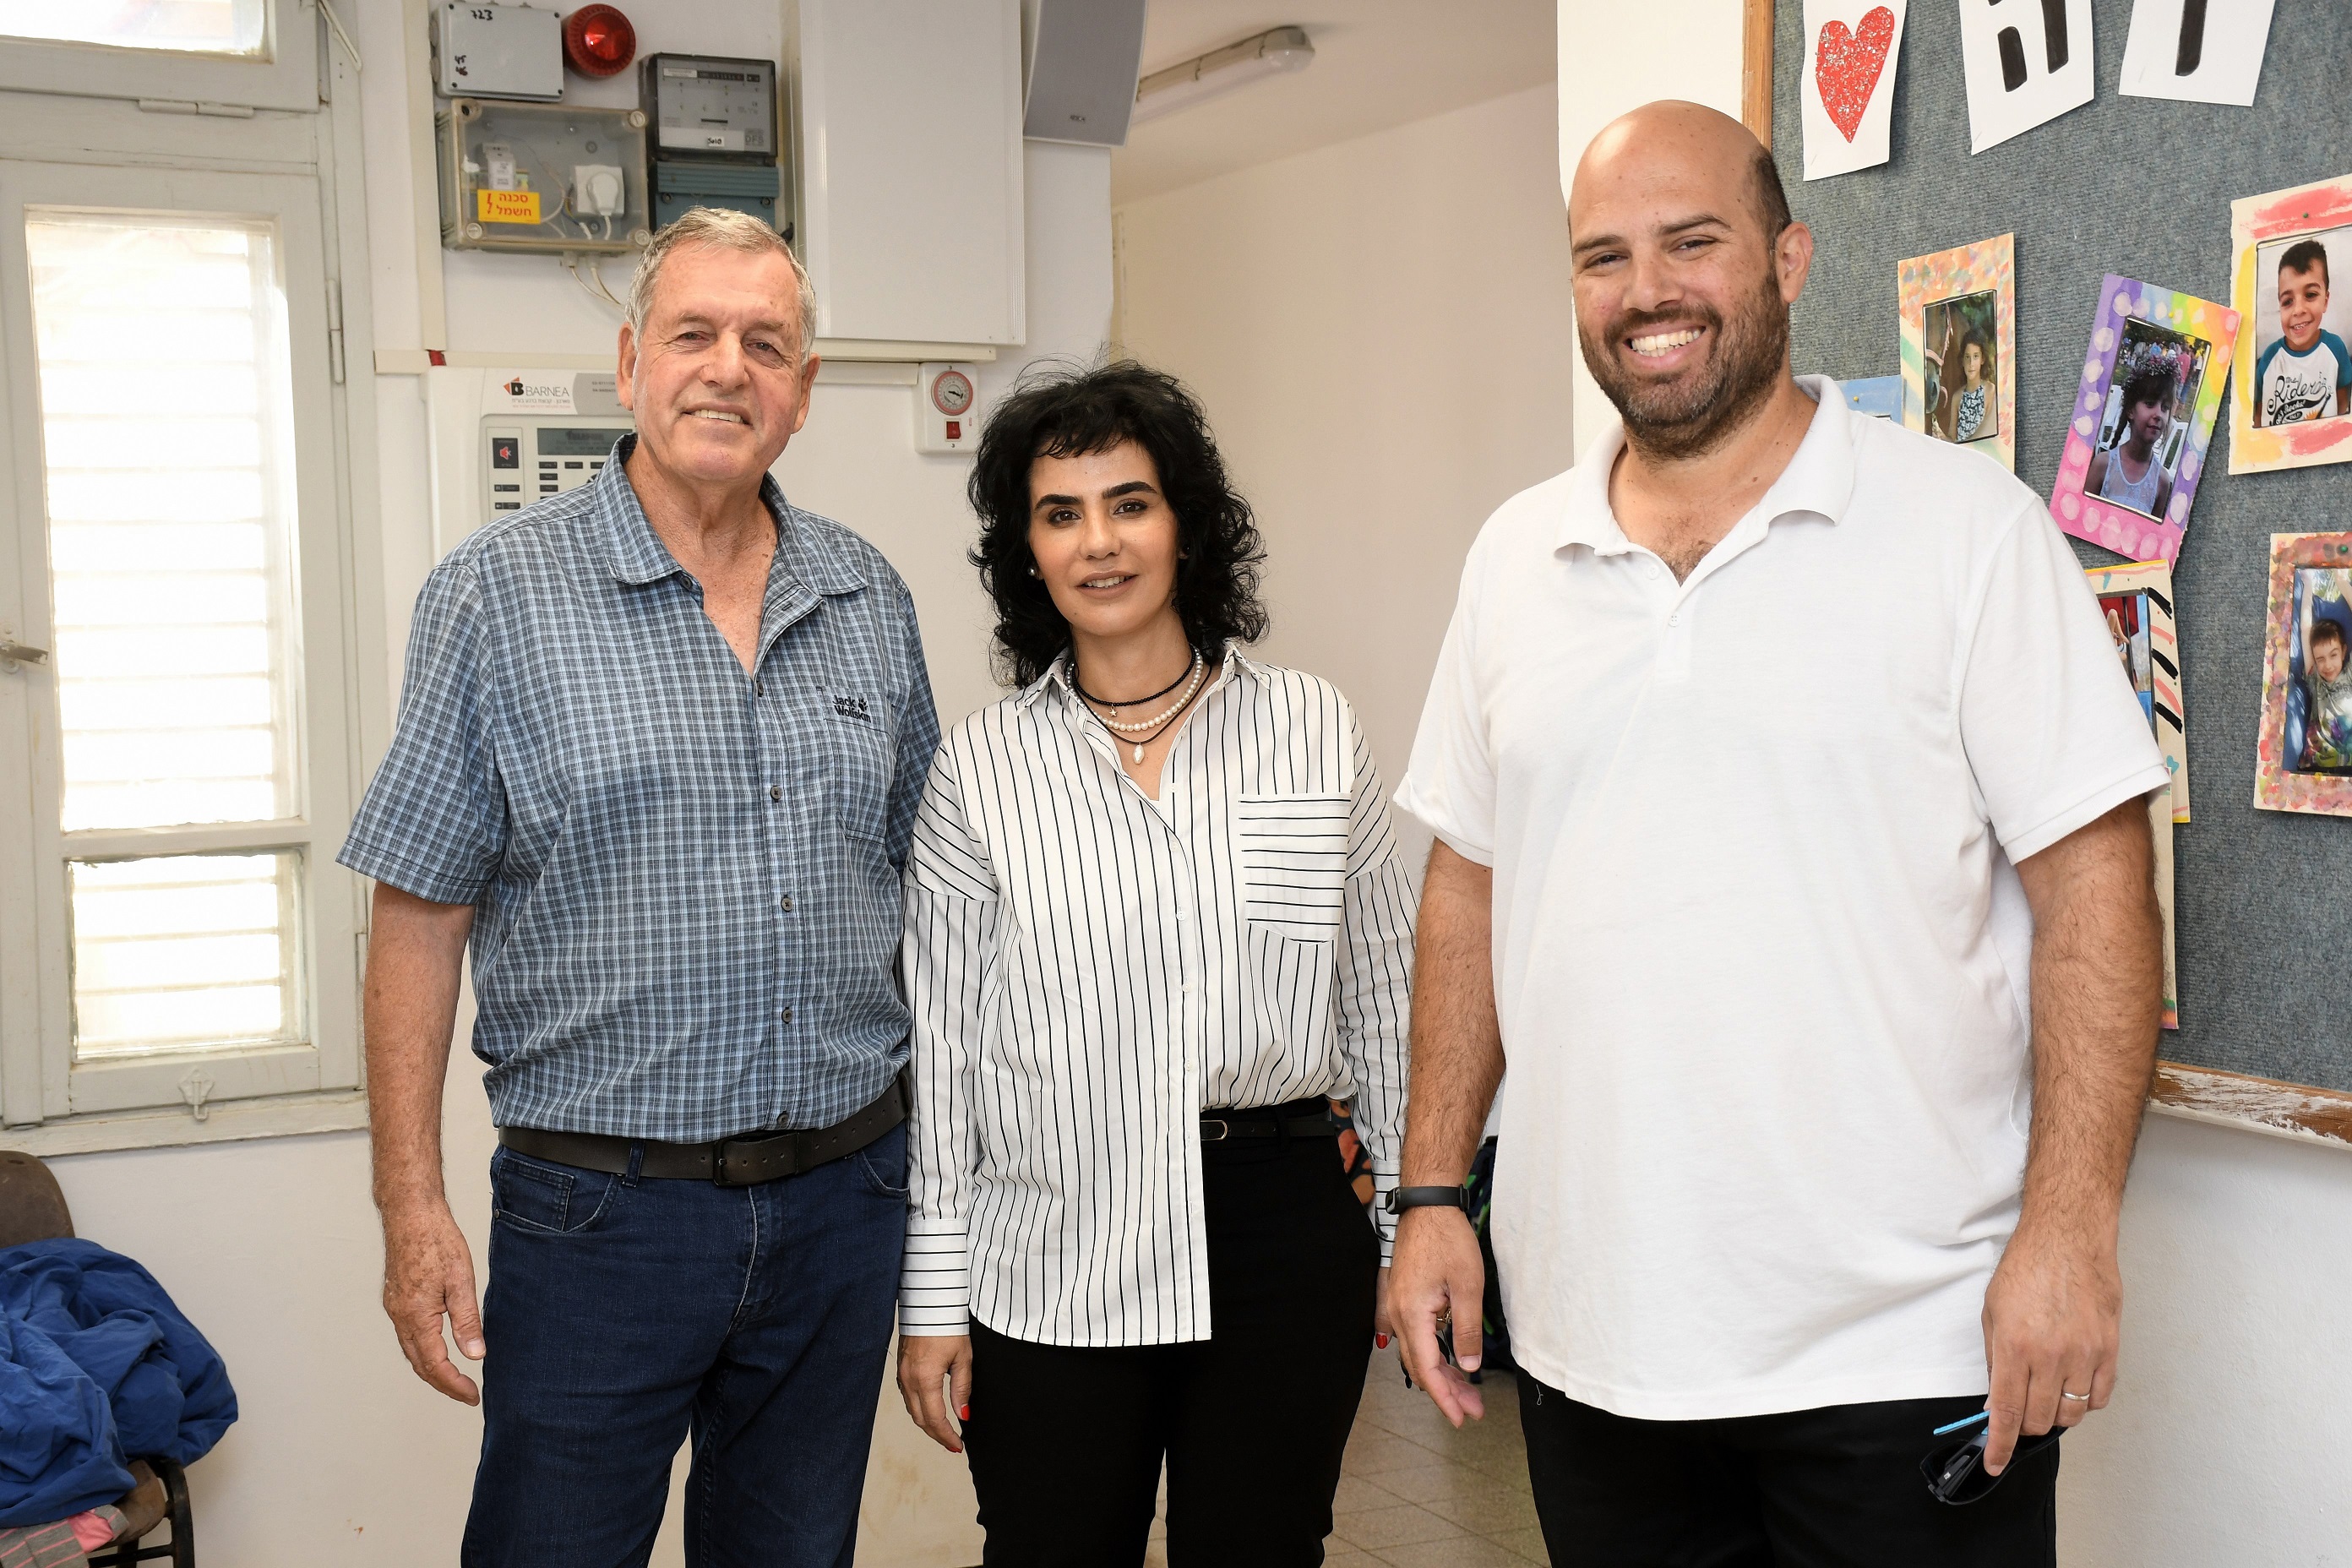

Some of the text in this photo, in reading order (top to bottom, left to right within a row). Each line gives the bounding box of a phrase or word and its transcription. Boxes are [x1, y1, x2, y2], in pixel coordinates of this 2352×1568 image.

[499, 193, 528, 204] סכנה
[497, 204, 531, 216] חשמל
[525, 385, 570, 397] BARNEA
[832, 694, 856, 708] Jack
[834, 705, 872, 723] Wolfskin
